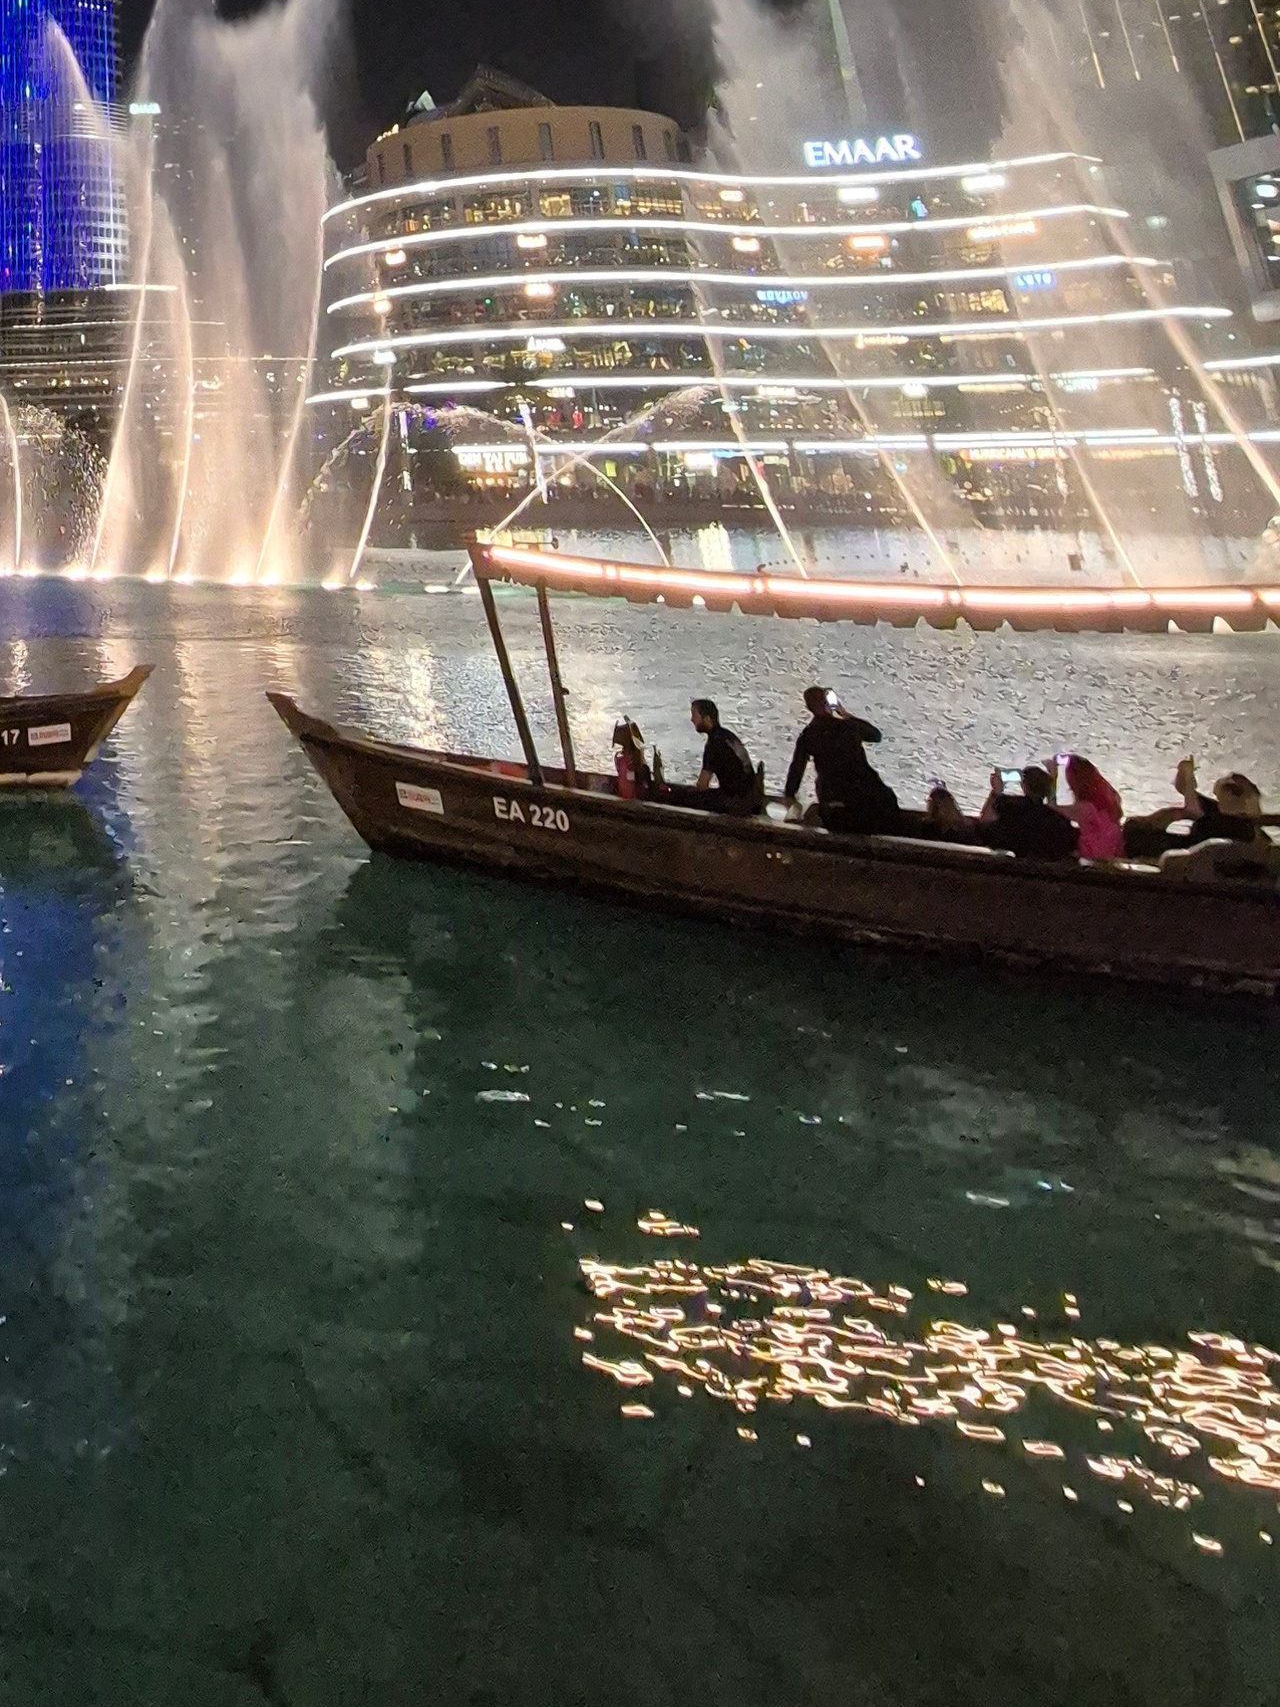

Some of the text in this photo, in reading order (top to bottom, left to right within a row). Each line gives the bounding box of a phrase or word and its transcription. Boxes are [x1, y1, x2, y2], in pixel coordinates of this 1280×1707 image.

[803, 134, 922, 167] EMAAR
[493, 796, 570, 832] EA 220
